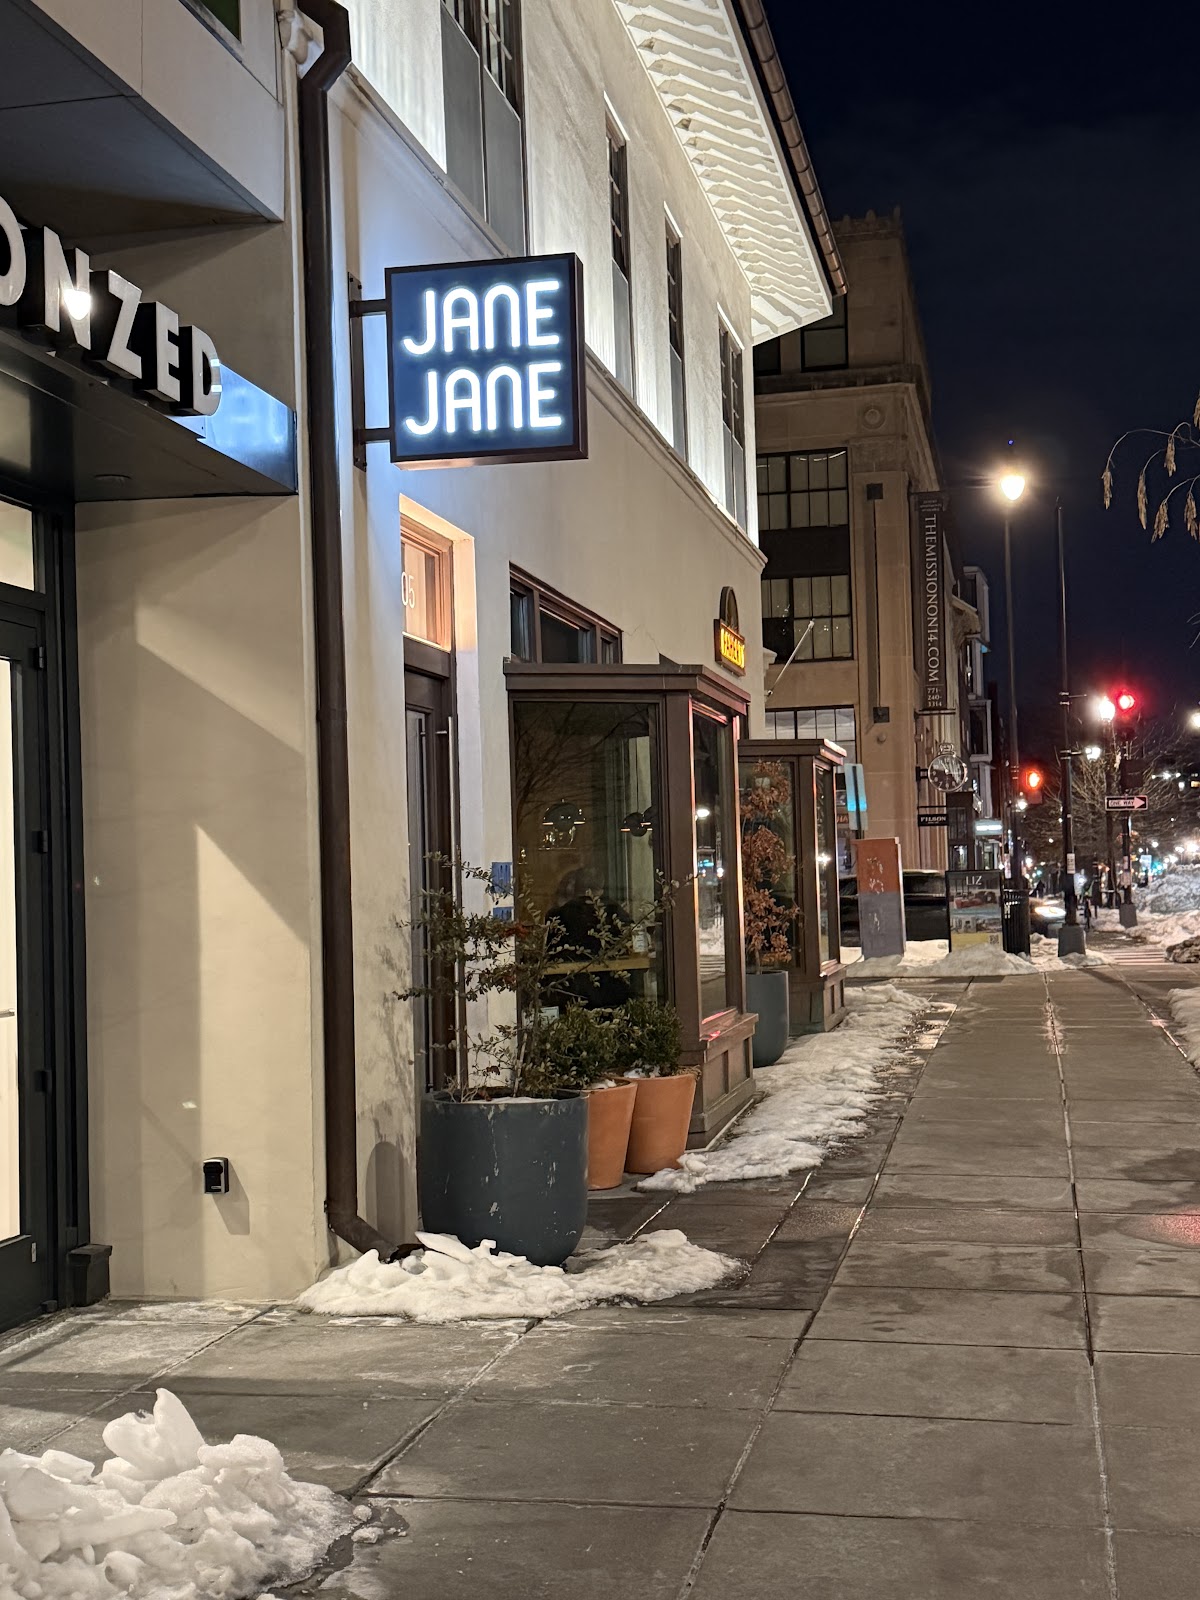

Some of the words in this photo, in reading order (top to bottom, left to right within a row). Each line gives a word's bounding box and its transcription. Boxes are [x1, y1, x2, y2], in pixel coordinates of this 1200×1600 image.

[403, 279, 561, 355] JANE
[405, 361, 563, 436] JANE
[924, 513, 939, 682] THEMISSIONON14.COM
[966, 876, 982, 885] LIZ
